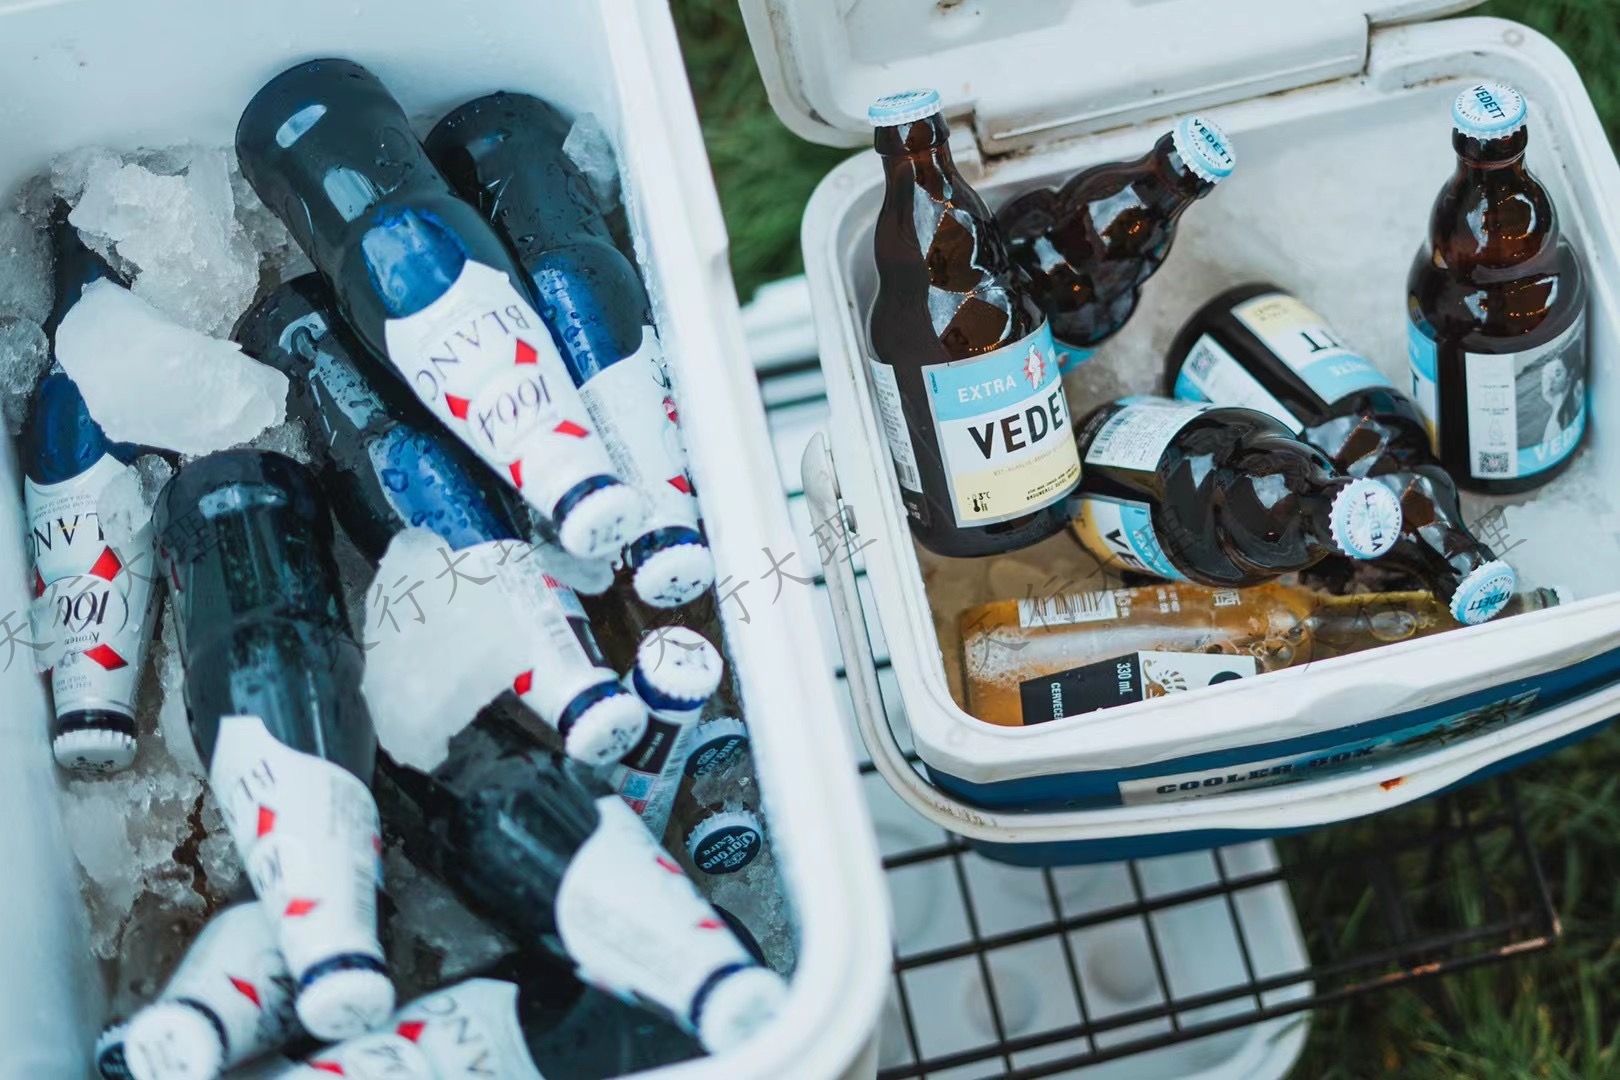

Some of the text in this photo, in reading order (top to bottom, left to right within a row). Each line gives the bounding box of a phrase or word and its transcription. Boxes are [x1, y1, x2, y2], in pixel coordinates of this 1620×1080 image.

[1473, 85, 1506, 119] VEDETT
[1194, 119, 1233, 165] VEDETT
[416, 304, 531, 401] BLANC
[957, 374, 1017, 403] EXTRA
[478, 374, 552, 447] 1664
[1364, 492, 1383, 552] VEDETT
[1468, 591, 1511, 611] VEDETT
[64, 631, 101, 647] Kronen
[1116, 662, 1133, 696] 330 ml.
[1156, 764, 1295, 795] COOLER
[703, 833, 736, 855] Extra
[703, 830, 757, 869] Corona
